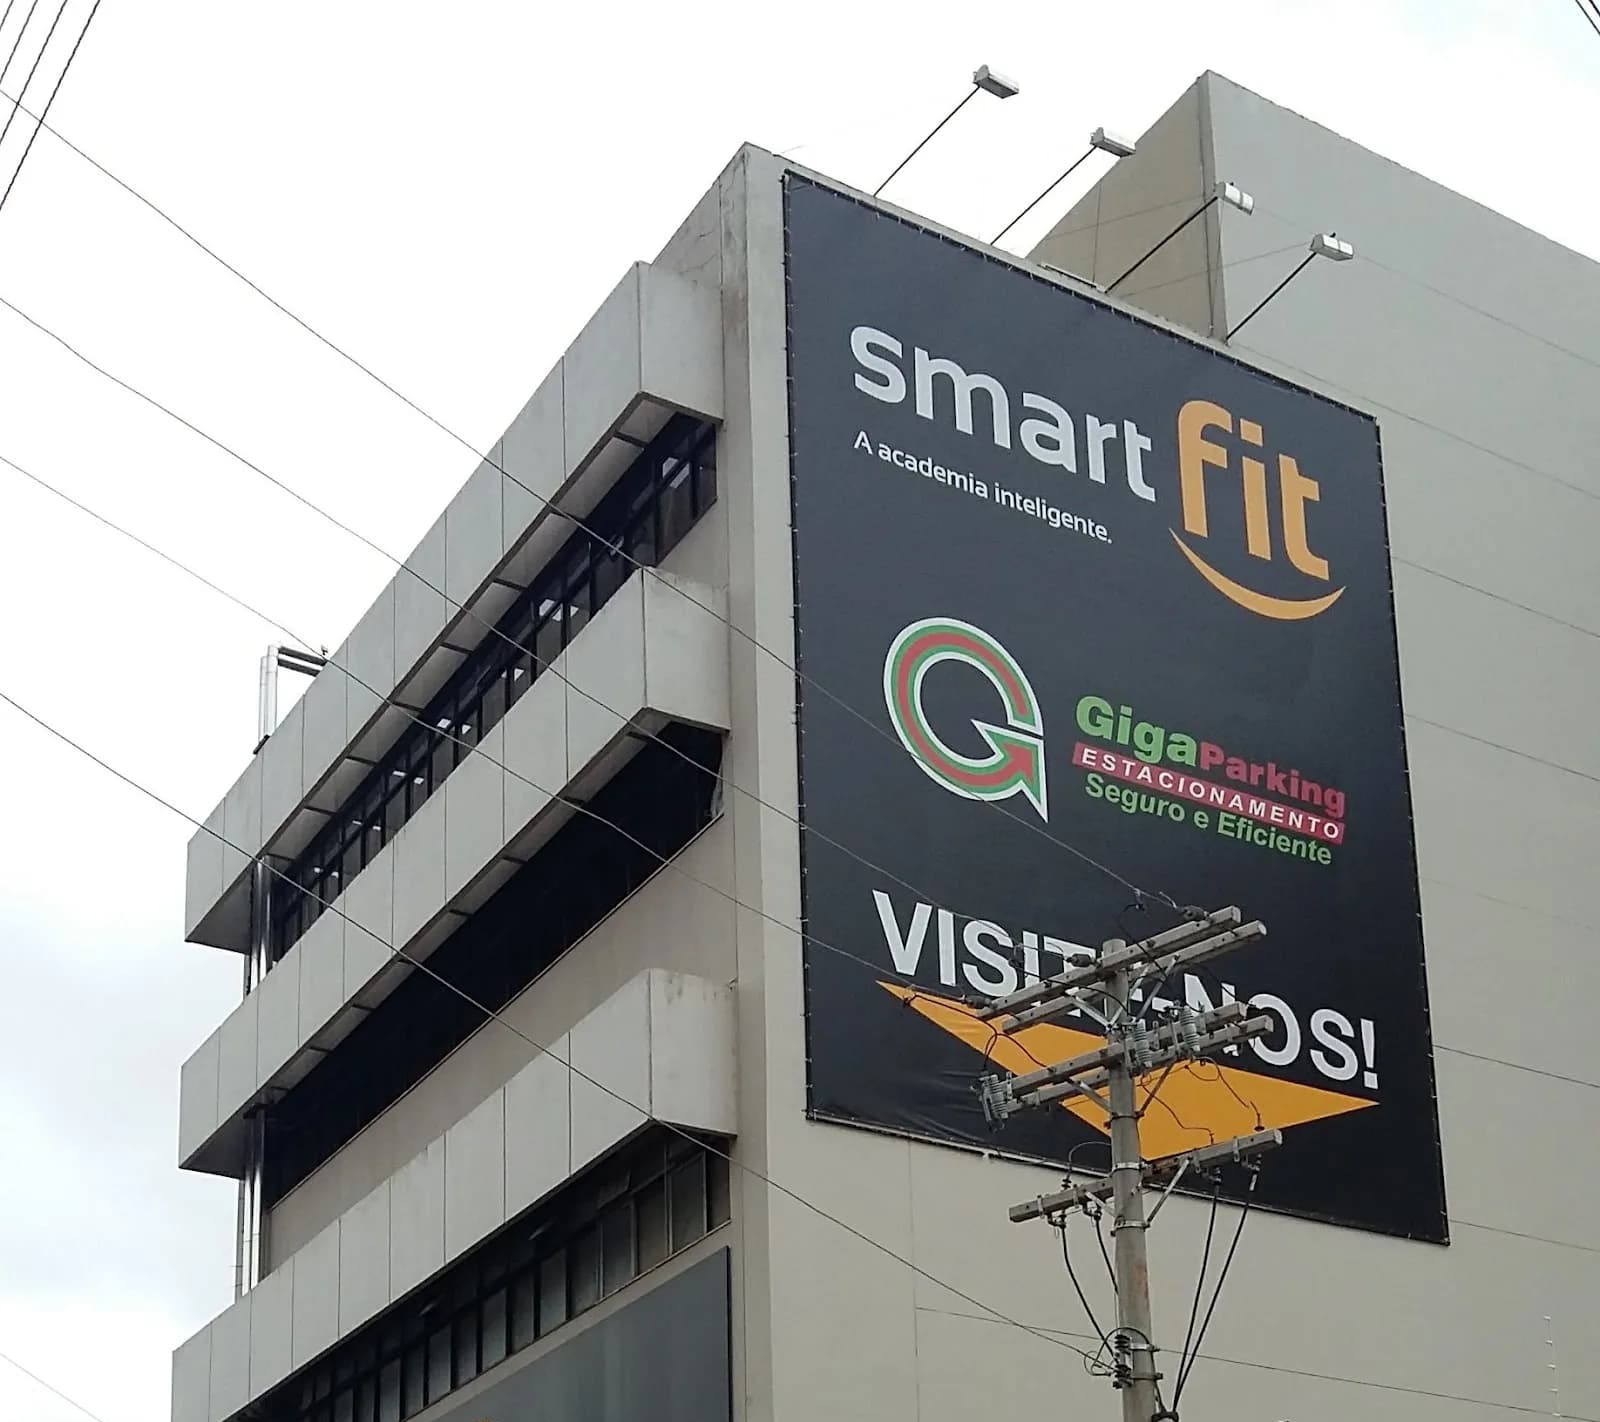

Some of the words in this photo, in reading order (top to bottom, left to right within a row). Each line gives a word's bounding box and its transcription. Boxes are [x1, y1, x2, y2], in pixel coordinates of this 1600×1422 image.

[850, 326, 1156, 501] smart
[1177, 400, 1329, 580] fit
[854, 431, 873, 454] A
[878, 443, 988, 498] academia
[994, 483, 1112, 543] inteligente.
[1082, 748, 1340, 839] ESTACIONAMENTO
[1085, 773, 1185, 822] Seguro
[1194, 810, 1209, 829] e
[1217, 811, 1332, 865] Eficiente
